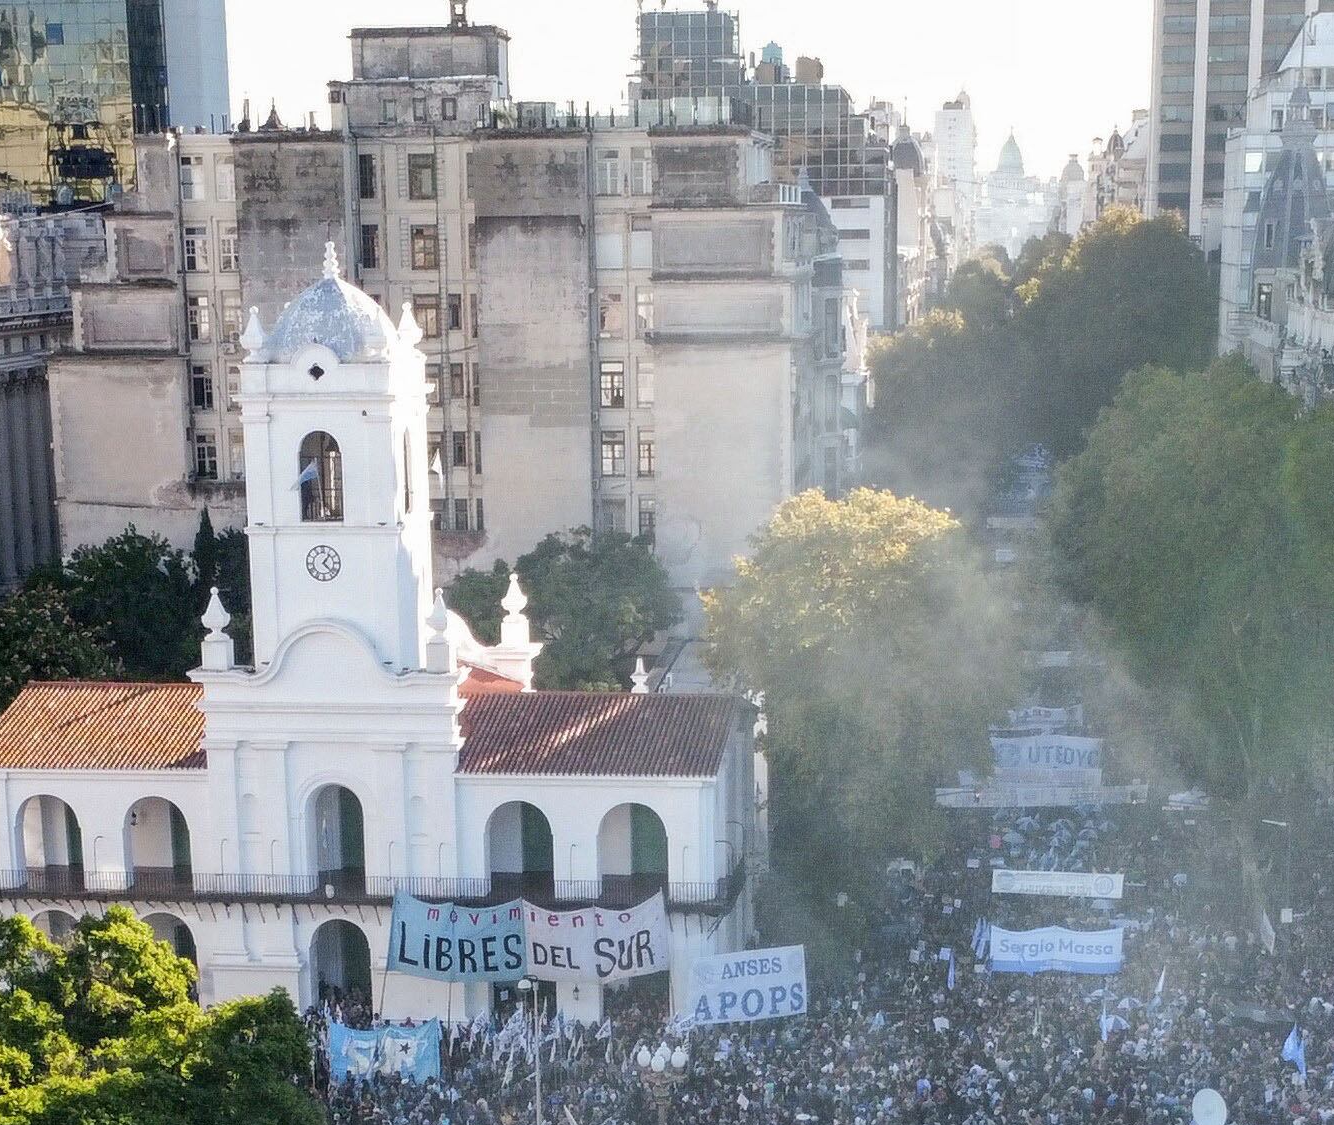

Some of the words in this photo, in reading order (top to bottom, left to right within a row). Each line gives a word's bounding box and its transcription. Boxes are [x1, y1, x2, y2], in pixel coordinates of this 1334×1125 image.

[533, 943, 580, 970] DEL
[594, 928, 656, 978] SUR
[999, 938, 1055, 958] Sergio
[1059, 939, 1114, 955] Massa
[721, 957, 783, 980] ANSES
[694, 983, 805, 1022] APOPS
